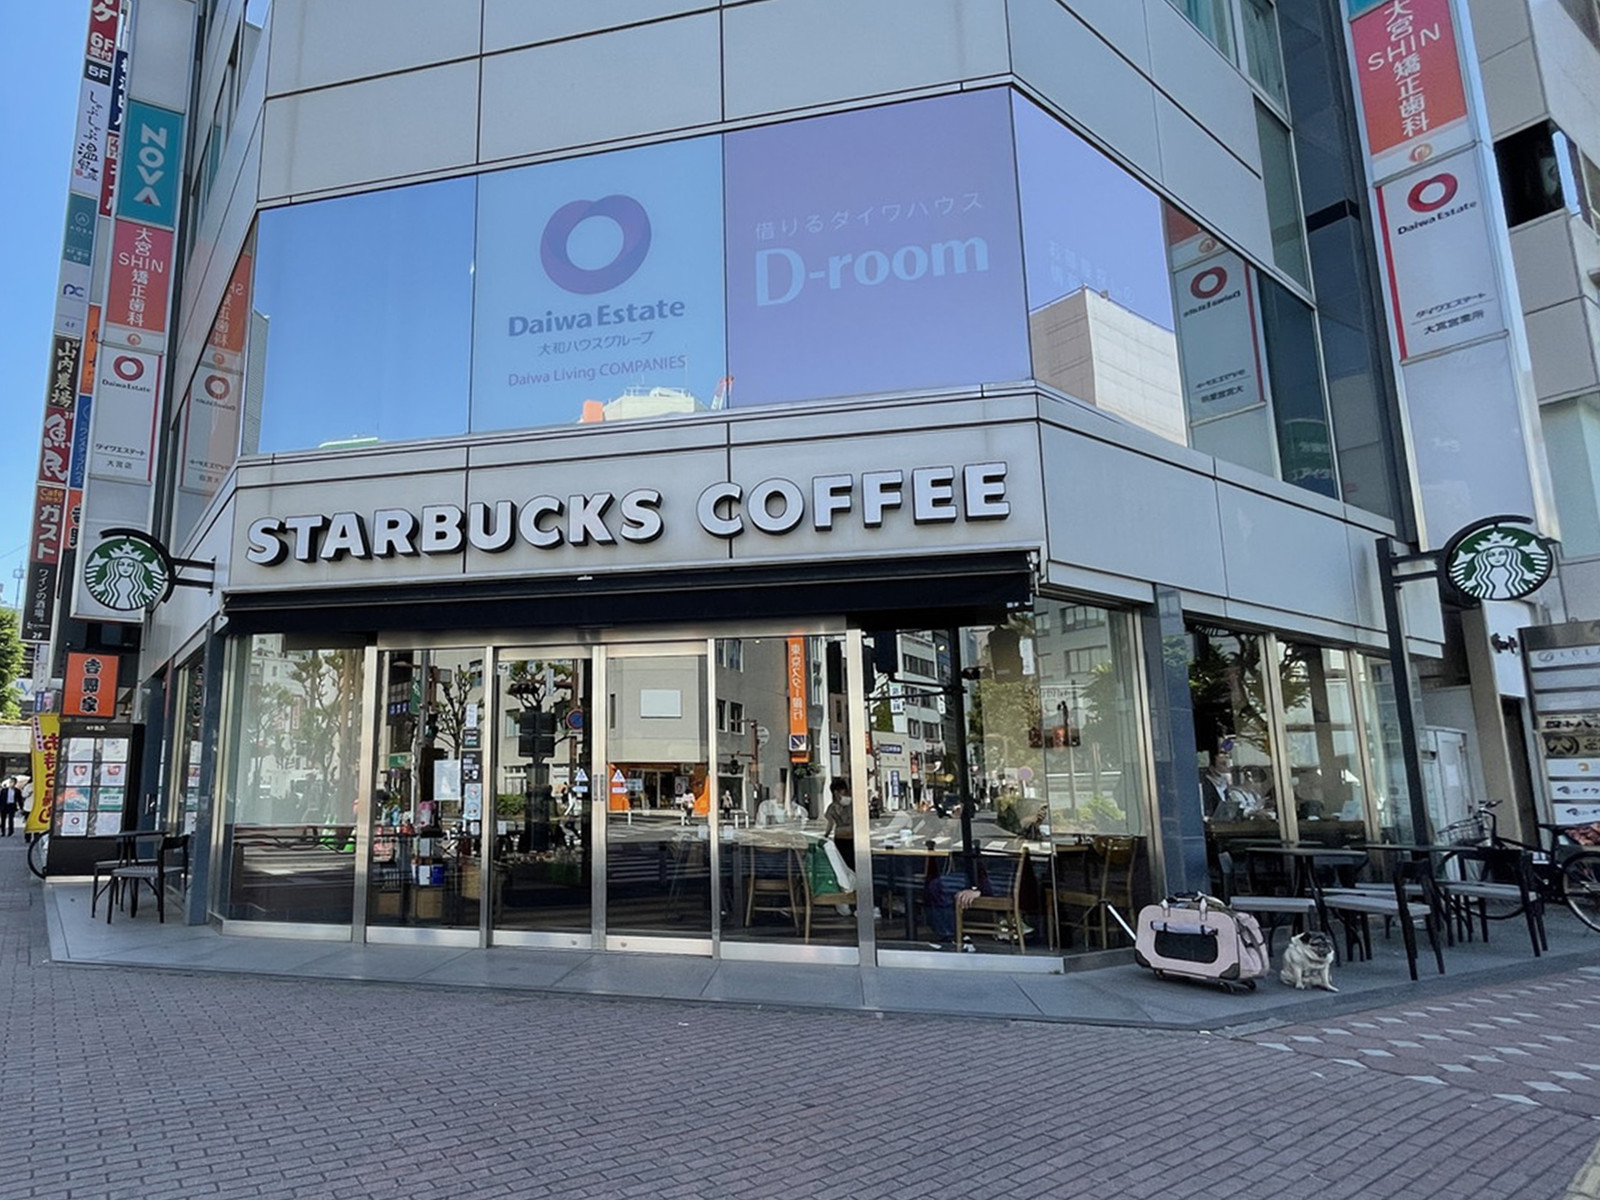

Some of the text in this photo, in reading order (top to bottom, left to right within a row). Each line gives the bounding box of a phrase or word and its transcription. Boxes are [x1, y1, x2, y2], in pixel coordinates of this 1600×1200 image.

[90, 32, 115, 50] 6F
[1368, 23, 1440, 71] SHIN
[88, 65, 109, 79] 5F
[1393, 54, 1430, 137] 矯正歯科
[133, 123, 167, 207] NOVA
[755, 191, 984, 242] 借りるダイワハウス
[1397, 201, 1478, 235] Daiwa Estate
[118, 228, 164, 327] 大宮 SHIN 矯正歯科
[755, 236, 990, 307] D-room
[508, 299, 686, 337] Daiwa Estate
[1415, 292, 1487, 319] ダイワエステート
[1424, 309, 1486, 336] 大宮営業所
[538, 331, 654, 357] 大和ハウスグループ
[51, 341, 77, 408] 山内農場
[508, 355, 687, 386] Daiwa Living COMPANIES
[37, 504, 62, 560] ガスト
[246, 462, 1011, 566] STARBUCKS COFFEE
[79, 658, 102, 714] 吉野家
